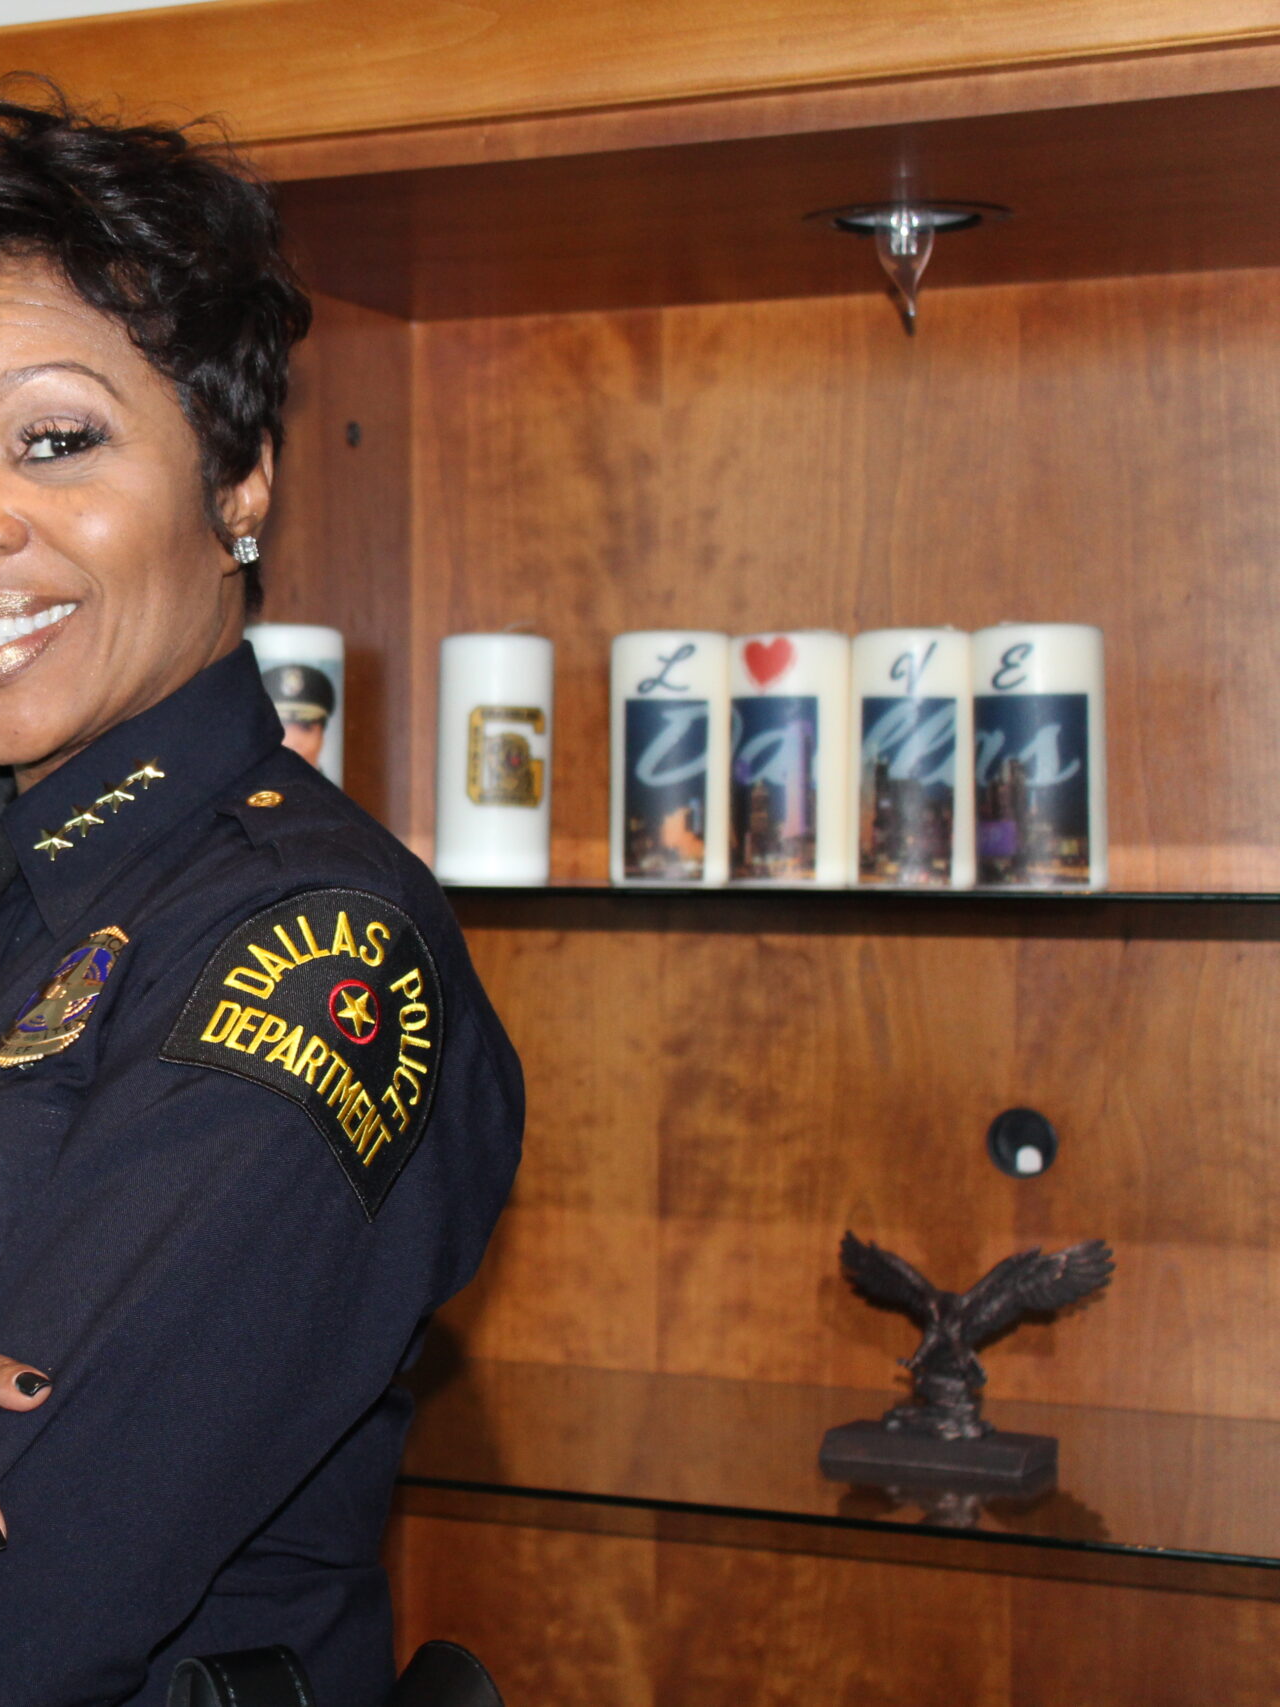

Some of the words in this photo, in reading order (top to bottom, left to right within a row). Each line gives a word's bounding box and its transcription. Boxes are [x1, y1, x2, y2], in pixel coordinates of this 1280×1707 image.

[200, 1000, 391, 1167] DEPARTMENT
[223, 911, 390, 999] DALLAS
[381, 967, 431, 1133] POLICE
